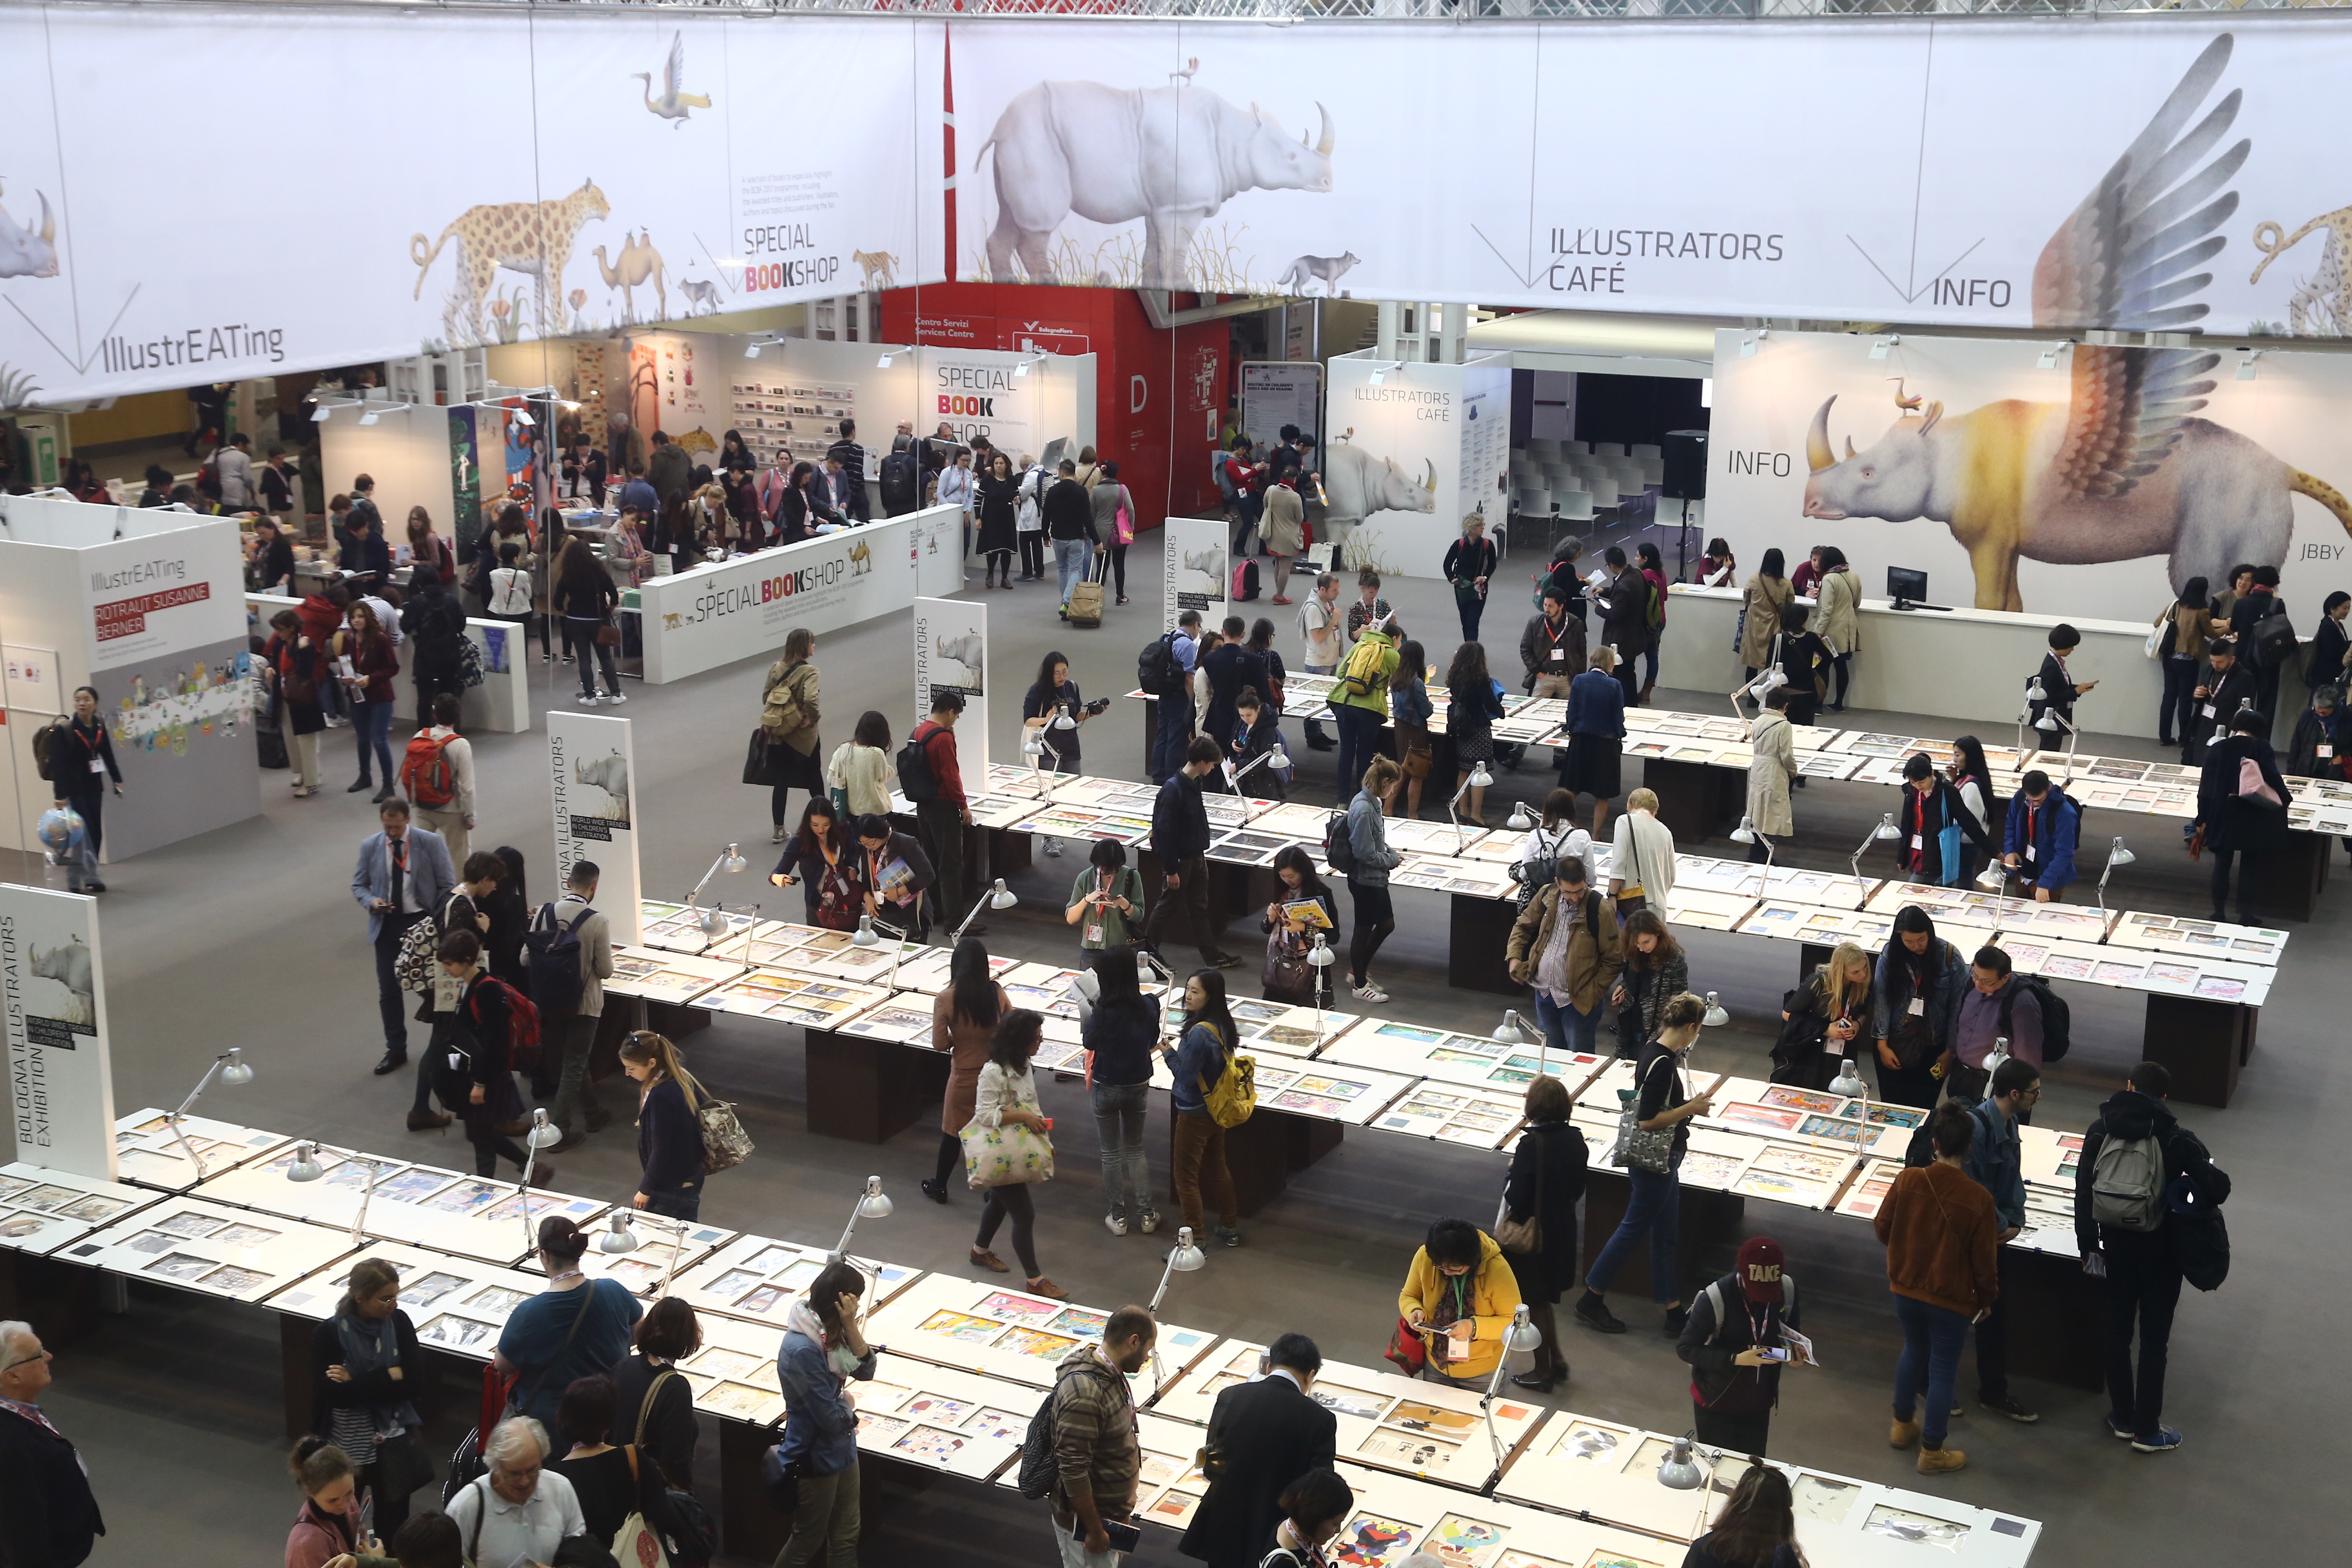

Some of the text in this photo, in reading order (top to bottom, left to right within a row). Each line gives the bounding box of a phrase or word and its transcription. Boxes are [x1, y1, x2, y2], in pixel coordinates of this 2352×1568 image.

[744, 222, 815, 255] SPECIAL
[1551, 228, 1783, 261] ILLUSTRATORS
[745, 256, 839, 292] BOOKSHOP
[1549, 261, 1625, 293] CAFÉ
[1933, 278, 2012, 308] INFO
[915, 317, 969, 328] Centro Servizi
[915, 327, 974, 338] Services Centre
[103, 322, 284, 374] IllustrEATing
[938, 367, 1017, 391] SPECIAL
[938, 395, 994, 416] BOOK
[1131, 375, 1147, 413] D
[1355, 387, 1450, 406] ILLUSTRATORS
[1416, 407, 1449, 421] CAFÉ
[1728, 451, 1791, 477] INFO
[2300, 543, 2346, 563] JBBY
[91, 558, 186, 592] IllustrEATing
[1167, 535, 1177, 614] ILLUSTRATORS
[95, 583, 206, 622] ROTRAUT SUSANNE
[96, 618, 144, 642] BERNER
[917, 618, 928, 710] ILLUSTRATORS
[551, 736, 569, 845] ILLUSTRATORS
[573, 830, 609, 840] ILLUSTRATION
[578, 824, 607, 833] CHILDREN'S
[606, 820, 627, 828] TRENDS
[0, 916, 25, 1052] ILLUSTRATORS
[26, 1017, 93, 1035] WORLD WIDE TRENDS
[28, 1024, 71, 1040] IN CHILDREN'S
[28, 1034, 71, 1049] ILLUSTRATION
[14, 1059, 33, 1144] BOLOGNA
[30, 1047, 51, 1148] EXHIBITION
[1748, 1264, 1780, 1282] TAKE
